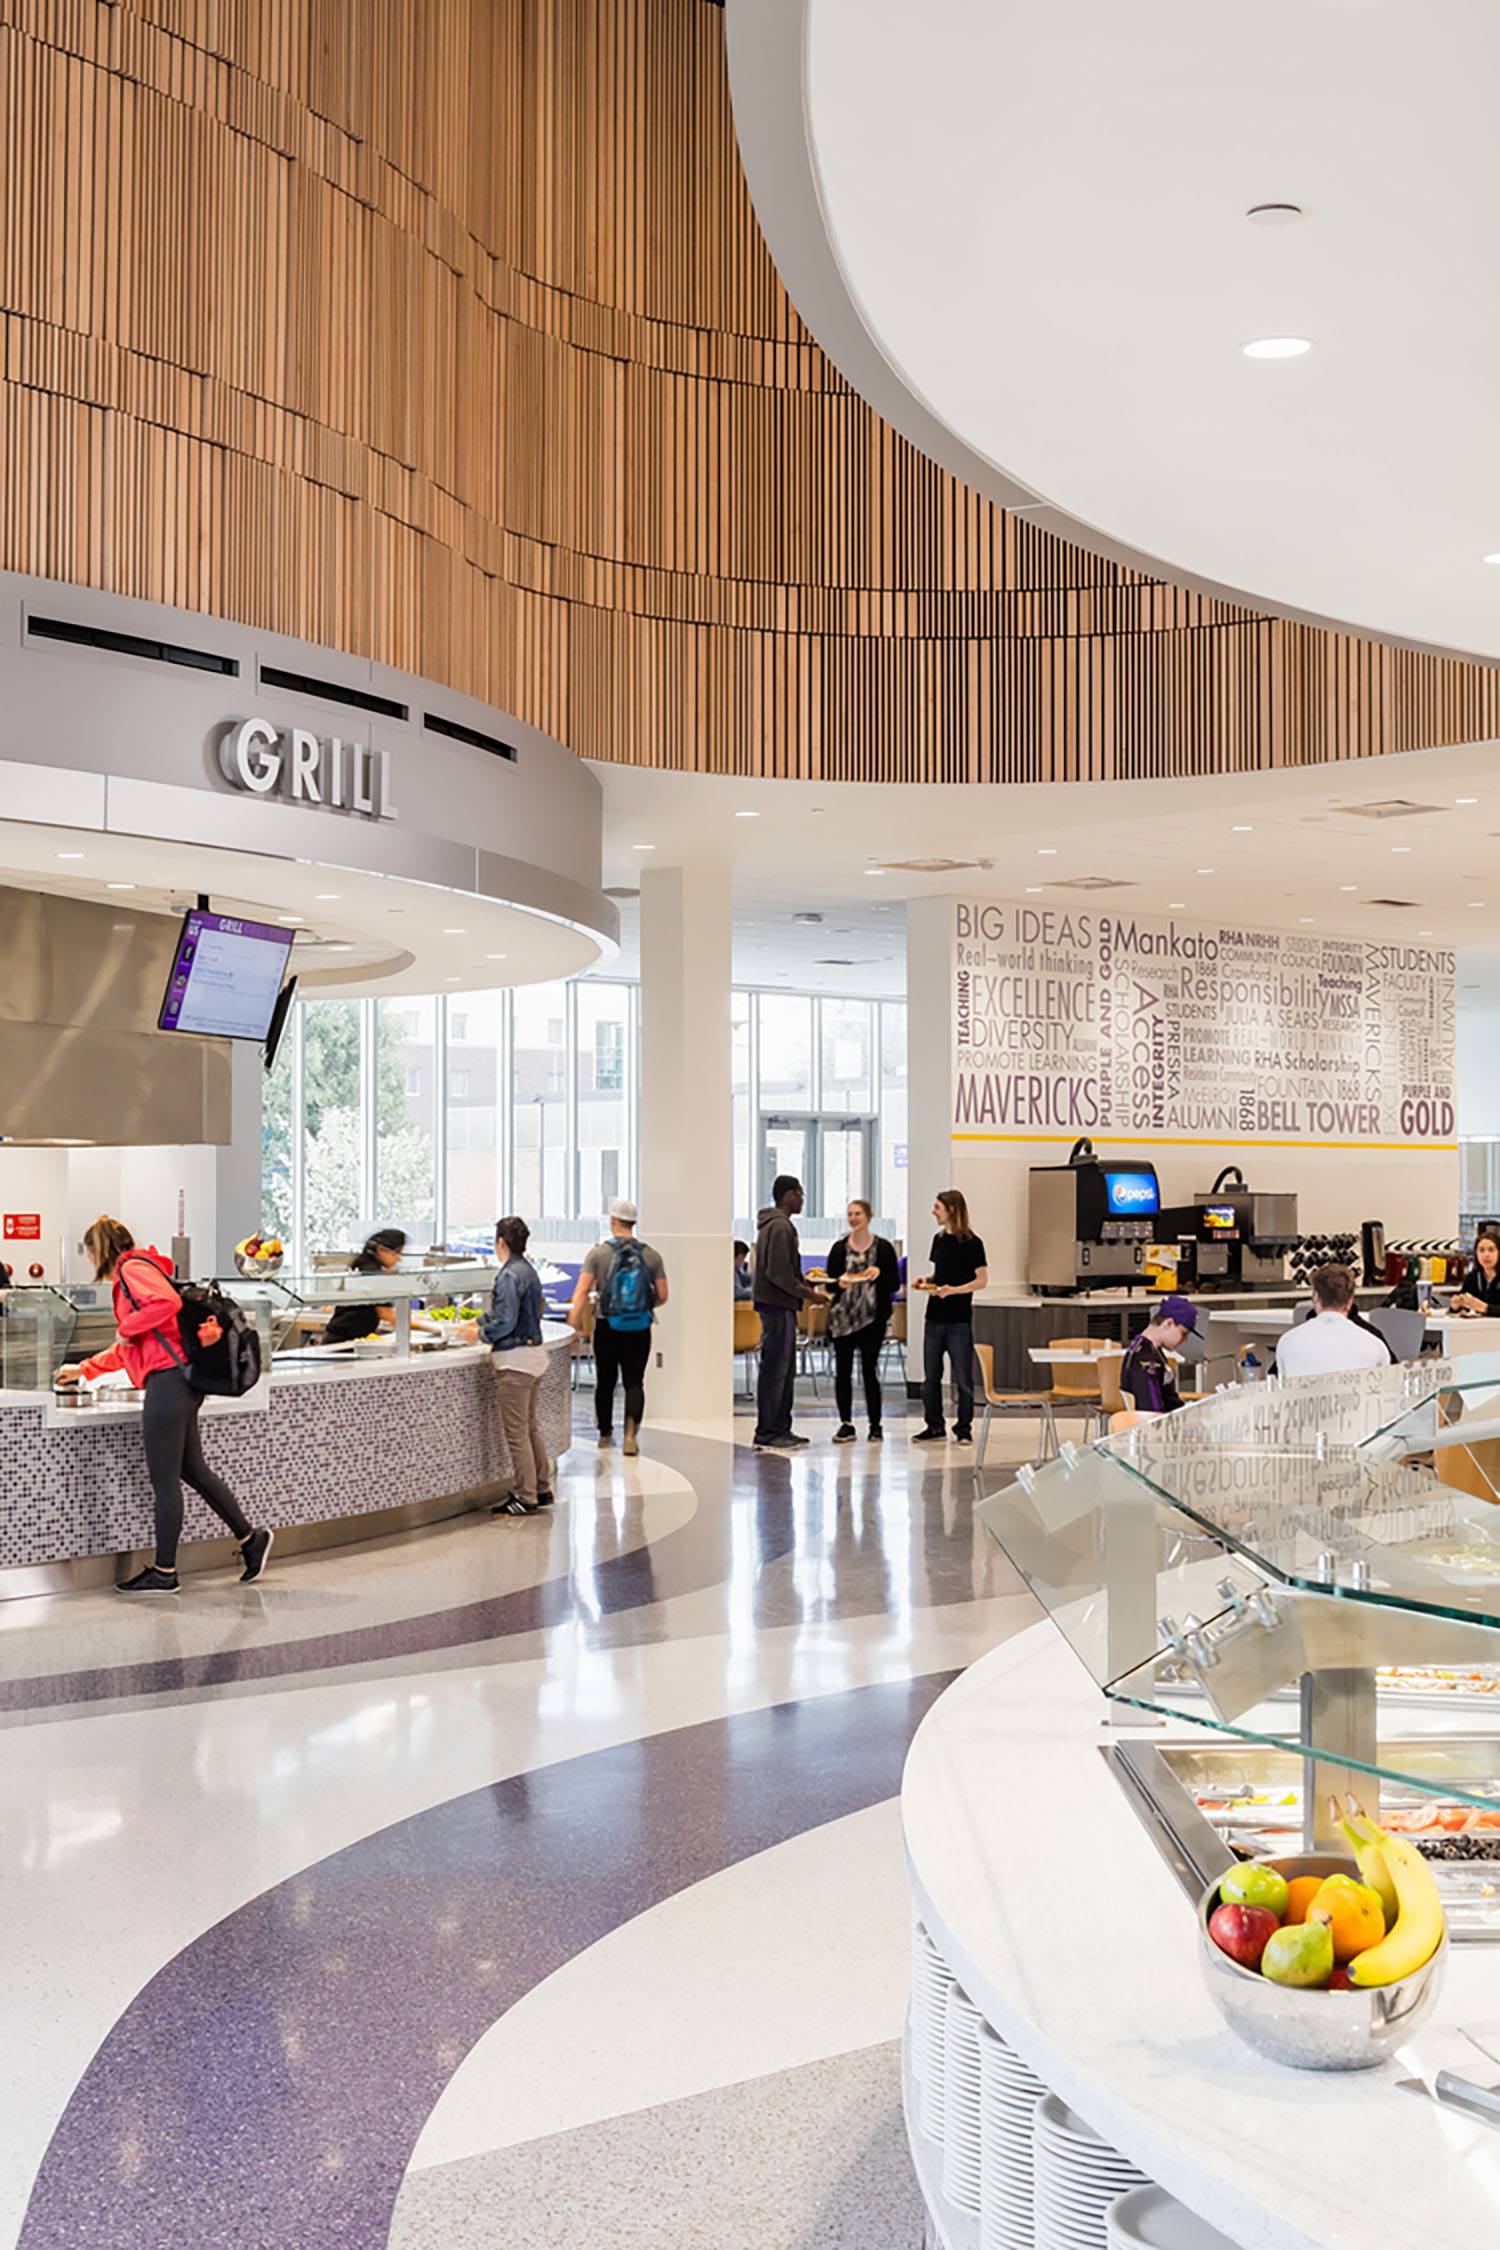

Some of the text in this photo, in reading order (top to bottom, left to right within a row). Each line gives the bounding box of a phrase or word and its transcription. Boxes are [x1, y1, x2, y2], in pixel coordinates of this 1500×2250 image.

[232, 717, 399, 820] GRILL
[219, 918, 243, 934] GRILL
[957, 903, 1092, 949] BIG IDEAS
[1113, 919, 1219, 961] Mankato
[1219, 929, 1280, 949] RHA NRHH
[1040, 948, 1094, 981] thinking
[1219, 947, 1278, 964] COMMUNITY
[1321, 951, 1364, 975] FOUNTAIN
[1380, 946, 1456, 974] STUDENTS
[973, 974, 1095, 1022] EXCELLENCE
[1181, 966, 1330, 1019] Responsibility
[1318, 973, 1362, 995] Teaching
[957, 970, 970, 1046] TEACHING
[1100, 917, 1112, 1128] PURPLE AND GOLD
[1165, 1002, 1217, 1021] STUDENTS
[1263, 1009, 1273, 1027] A
[1278, 1009, 1319, 1031] SEARS
[1365, 942, 1382, 1102] MAVERICKS
[972, 1017, 1075, 1050] DIVERSITY
[1114, 958, 1130, 1127] SCHOLARSHIP
[1183, 1027, 1230, 1044] PROMOTE
[957, 1050, 1098, 1073] PROMOTE LEARNING
[1152, 1014, 1164, 1128] INTEGRITY
[1167, 1020, 1181, 1100] PRESKA
[1183, 1047, 1251, 1066] LEARNING
[1254, 1050, 1361, 1078] RHA Scholarship
[955, 1073, 1099, 1127] MAVERICKS
[1258, 1075, 1360, 1101] FOUNTAIN 1868
[1434, 1086, 1451, 1099] AND
[1166, 1105, 1238, 1129] ALUMNI
[1239, 1089, 1256, 1131] 1868
[1258, 1100, 1381, 1134] BELL TOWER
[1400, 1099, 1454, 1136] GOLD
